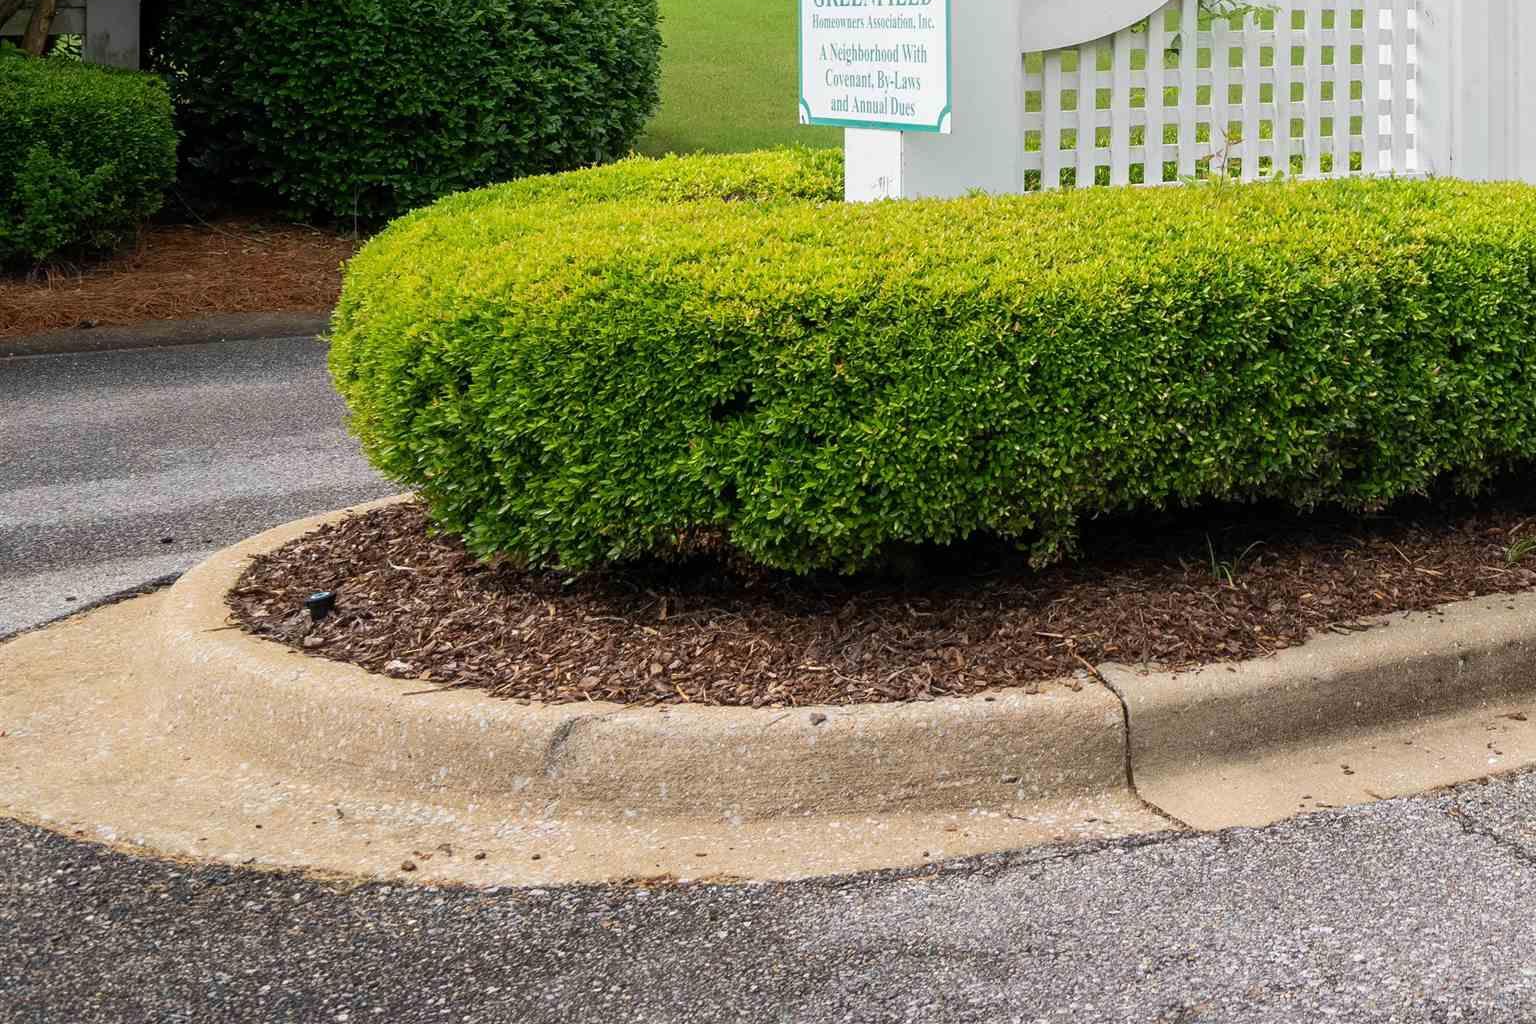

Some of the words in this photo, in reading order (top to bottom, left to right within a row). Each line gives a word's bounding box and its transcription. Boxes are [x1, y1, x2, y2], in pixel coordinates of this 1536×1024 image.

[812, 13, 865, 29] Homeowners
[918, 13, 935, 29] Inc.
[819, 45, 828, 62] A
[830, 42, 899, 65] Neighborhood
[902, 45, 927, 64] With
[877, 70, 921, 94] By-Laws
[831, 94, 849, 112] and
[851, 95, 888, 115] Annual
[890, 96, 915, 116] Dues
